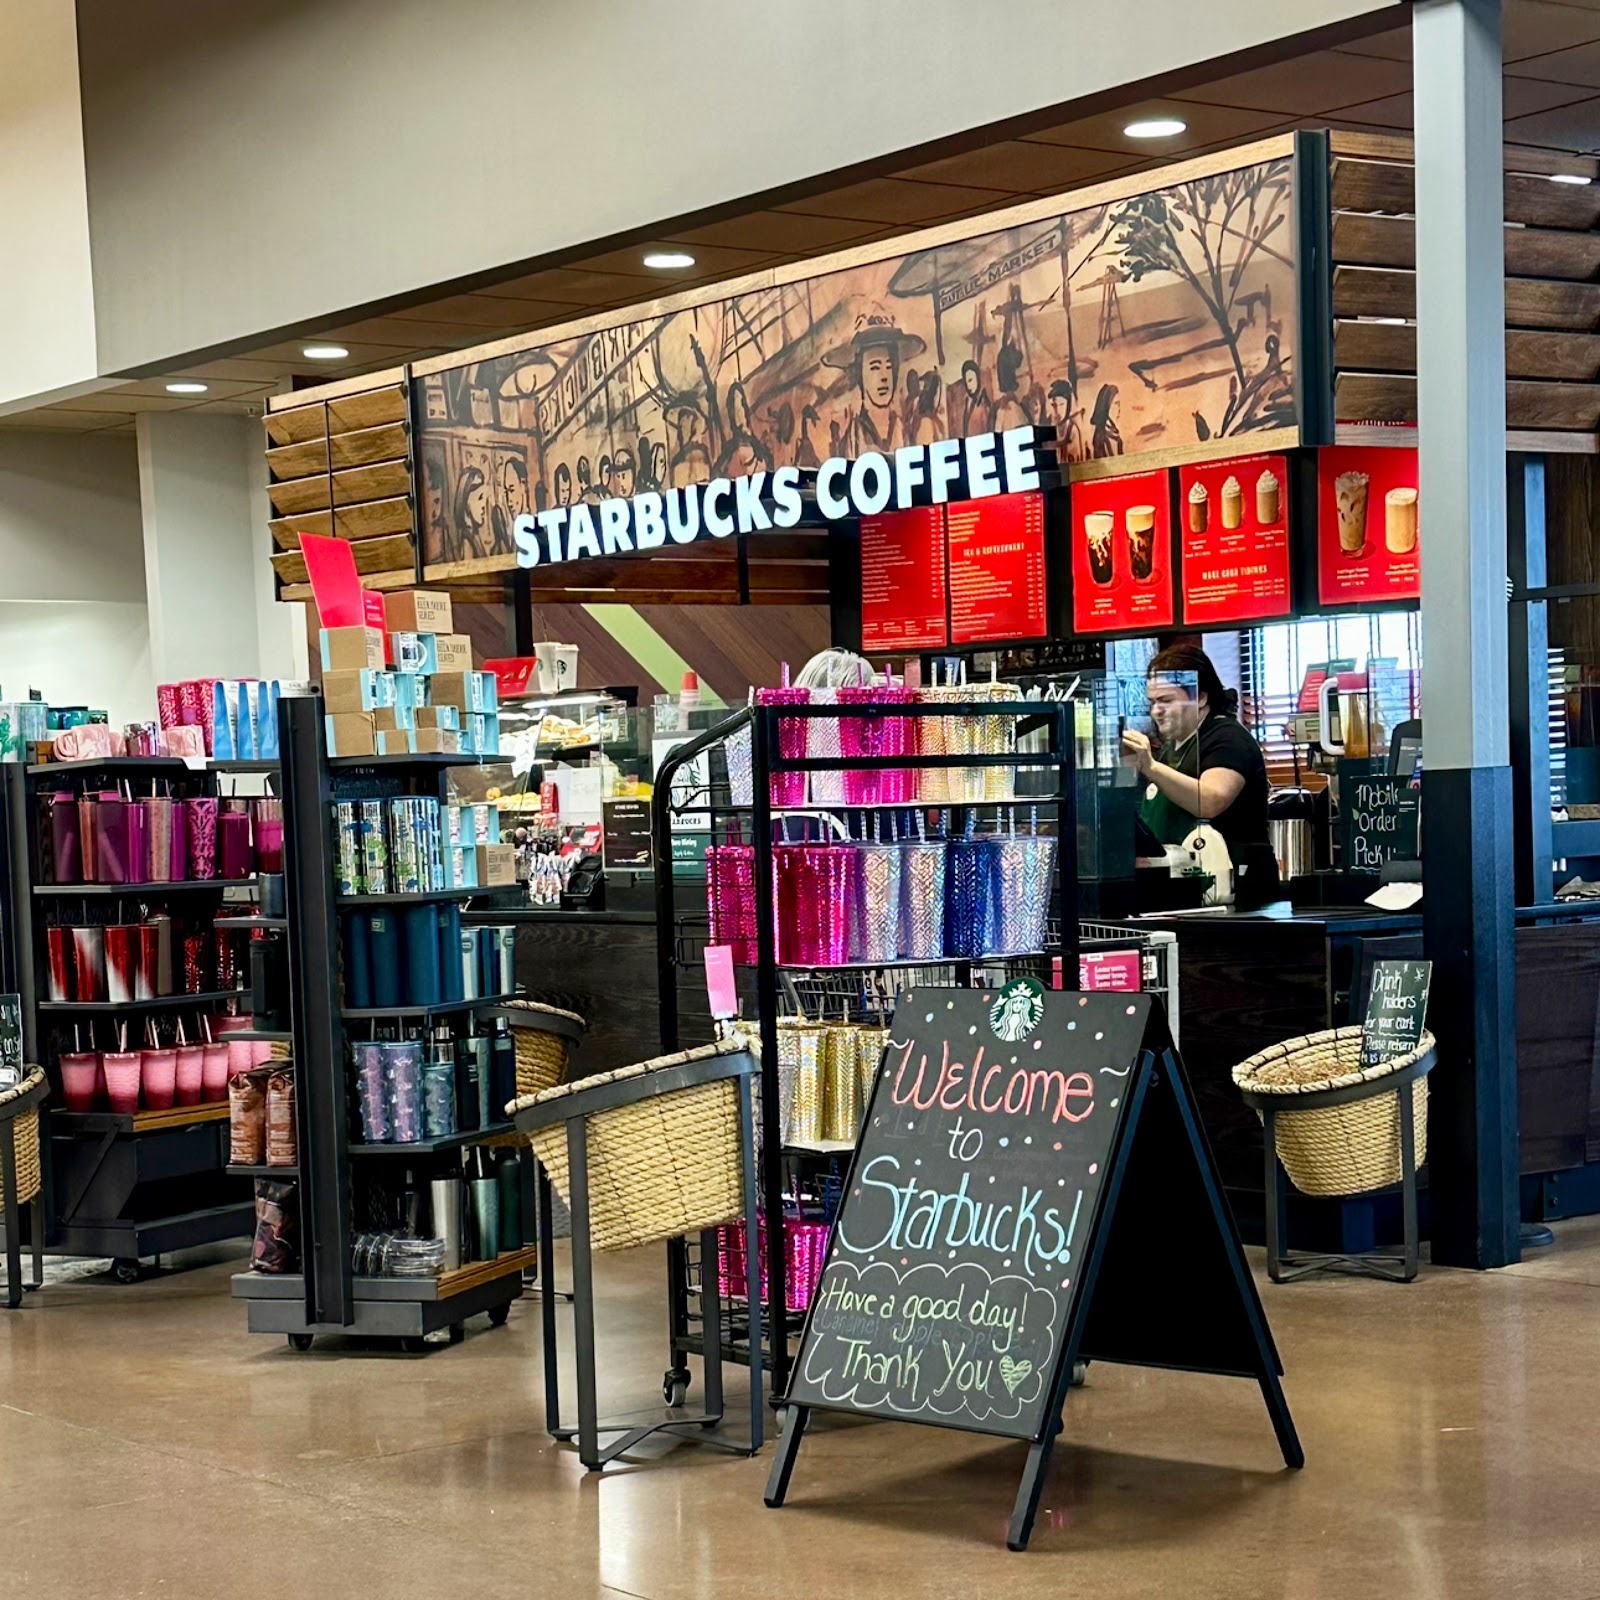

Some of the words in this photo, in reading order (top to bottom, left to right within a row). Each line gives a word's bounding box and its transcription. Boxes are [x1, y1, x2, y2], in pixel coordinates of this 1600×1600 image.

[987, 234, 1057, 282] MARKET
[513, 465, 803, 568] STARBUCKS
[815, 425, 1040, 520] COFFEE
[1358, 808, 1398, 832] Order
[1354, 835, 1383, 866] Pick
[1372, 968, 1403, 998] Drink
[1395, 1015, 1415, 1030] cart
[890, 1039, 1095, 1124] Welcome
[948, 1116, 984, 1162] to
[838, 1155, 1083, 1277] Starbucks!
[824, 1276, 878, 1313] Have
[880, 1294, 895, 1319] a
[893, 1283, 963, 1343] good
[969, 1289, 1028, 1353] day!
[836, 1336, 923, 1402] Thank
[933, 1339, 995, 1398] You
